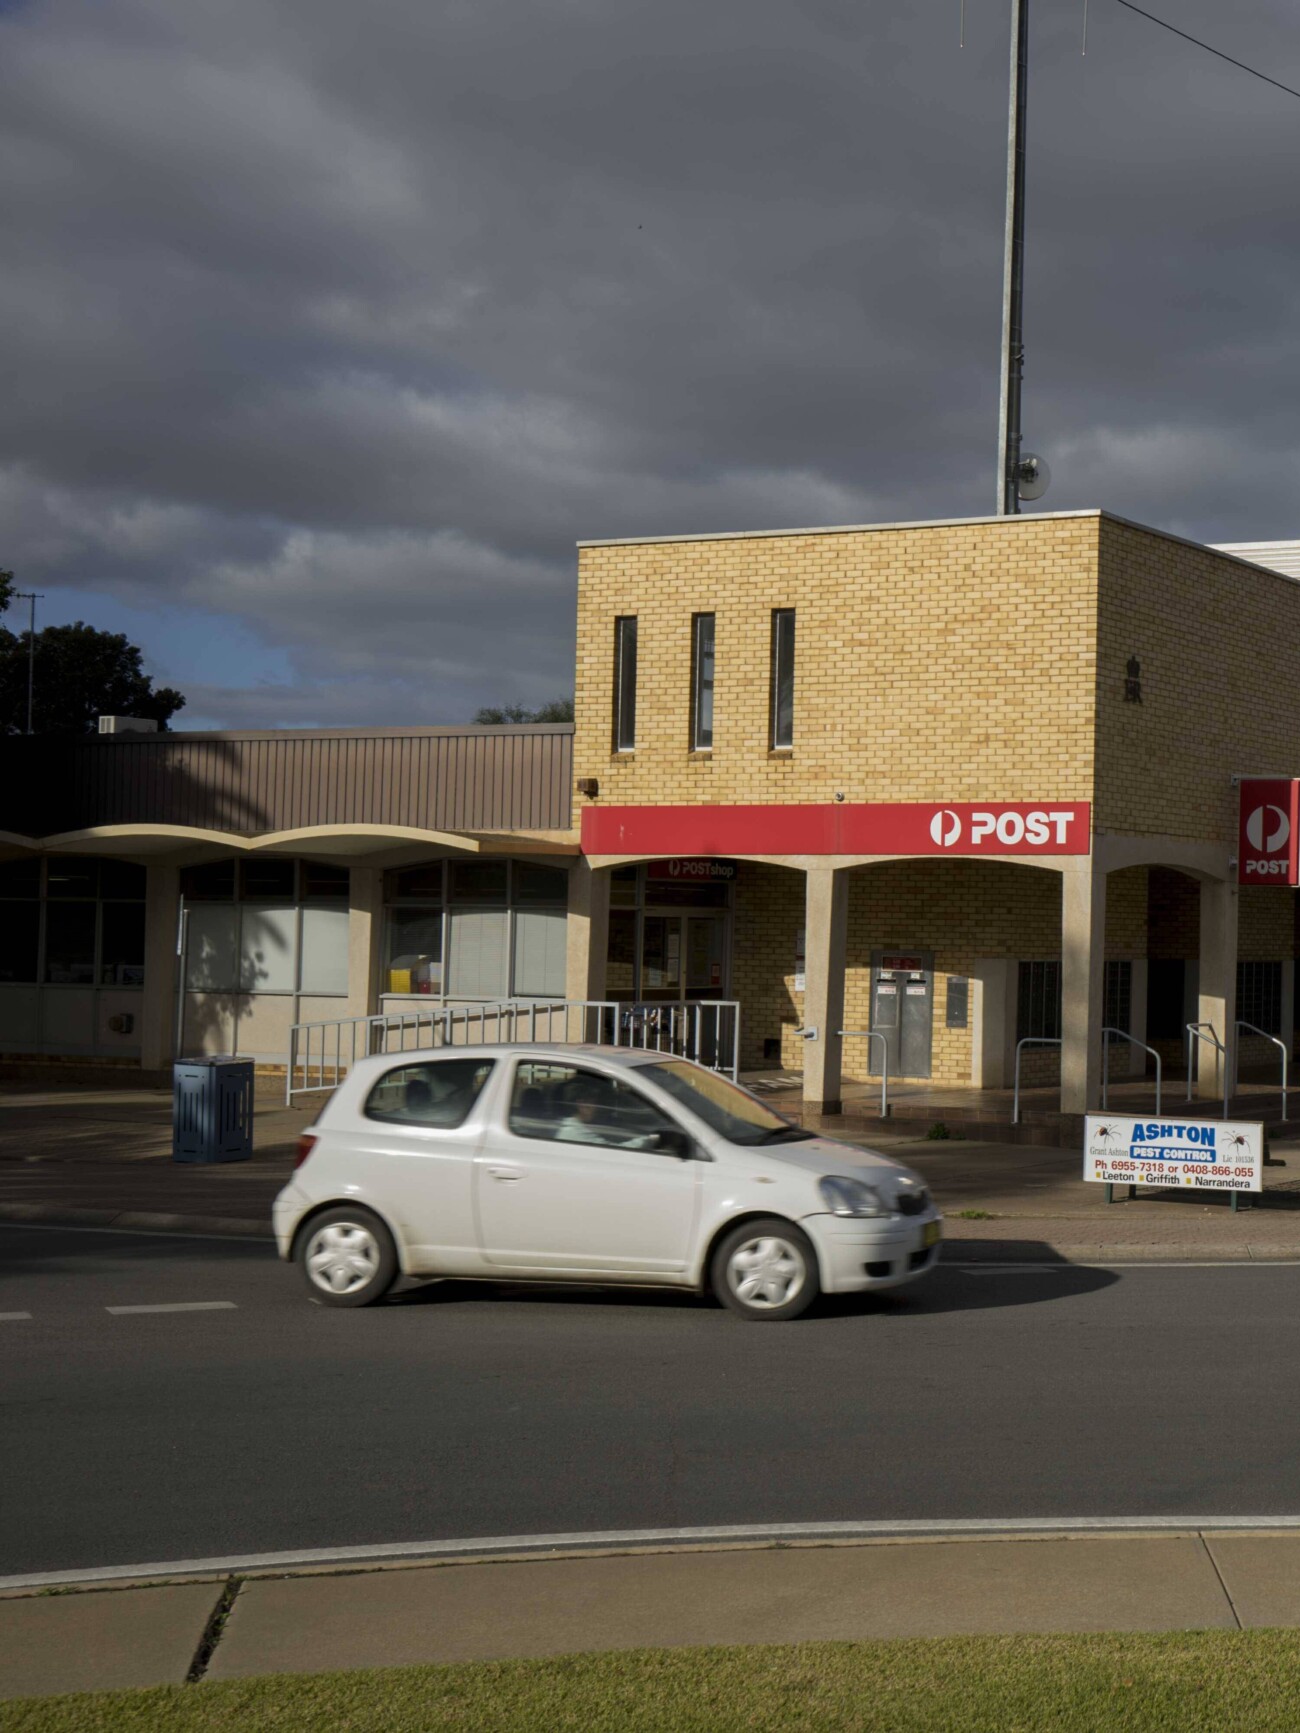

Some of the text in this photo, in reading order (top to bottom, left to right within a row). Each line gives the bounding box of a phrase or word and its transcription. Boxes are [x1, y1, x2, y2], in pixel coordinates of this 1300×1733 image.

[971, 811, 1075, 845] POST
[1245, 859, 1290, 875] POST
[1131, 1123, 1215, 1147] ASHTON
[1089, 1146, 1129, 1157] Grant Ashton
[1133, 1147, 1213, 1161] PEST CONTROL
[1095, 1160, 1254, 1177] Ph 6955-7318 or 0408-866-055
[1102, 1171, 1251, 1189] Leeton Griffith Narrandera
